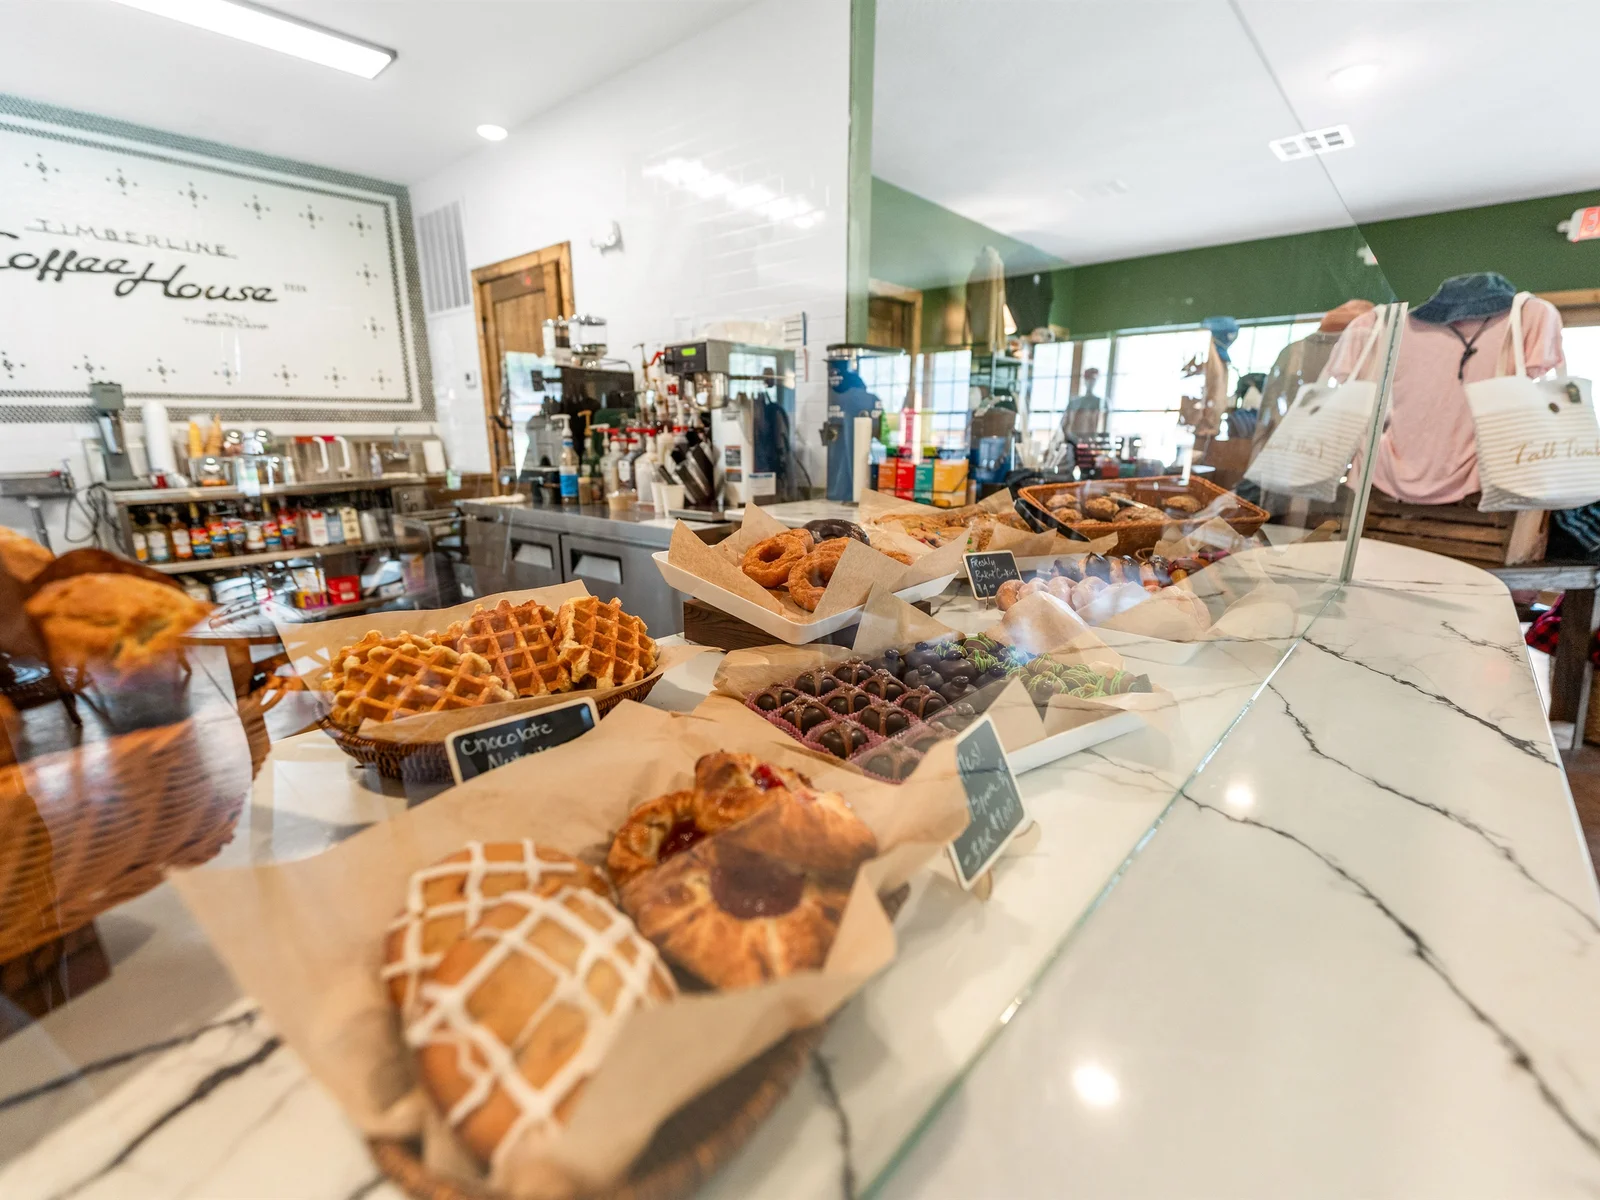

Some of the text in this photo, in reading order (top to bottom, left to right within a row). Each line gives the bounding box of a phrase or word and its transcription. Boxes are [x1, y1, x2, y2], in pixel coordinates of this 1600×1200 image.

[36, 218, 231, 257] TIMBERLINE
[115, 262, 278, 302] House
[1508, 440, 1558, 465] Tall
[970, 557, 997, 571] Freshly
